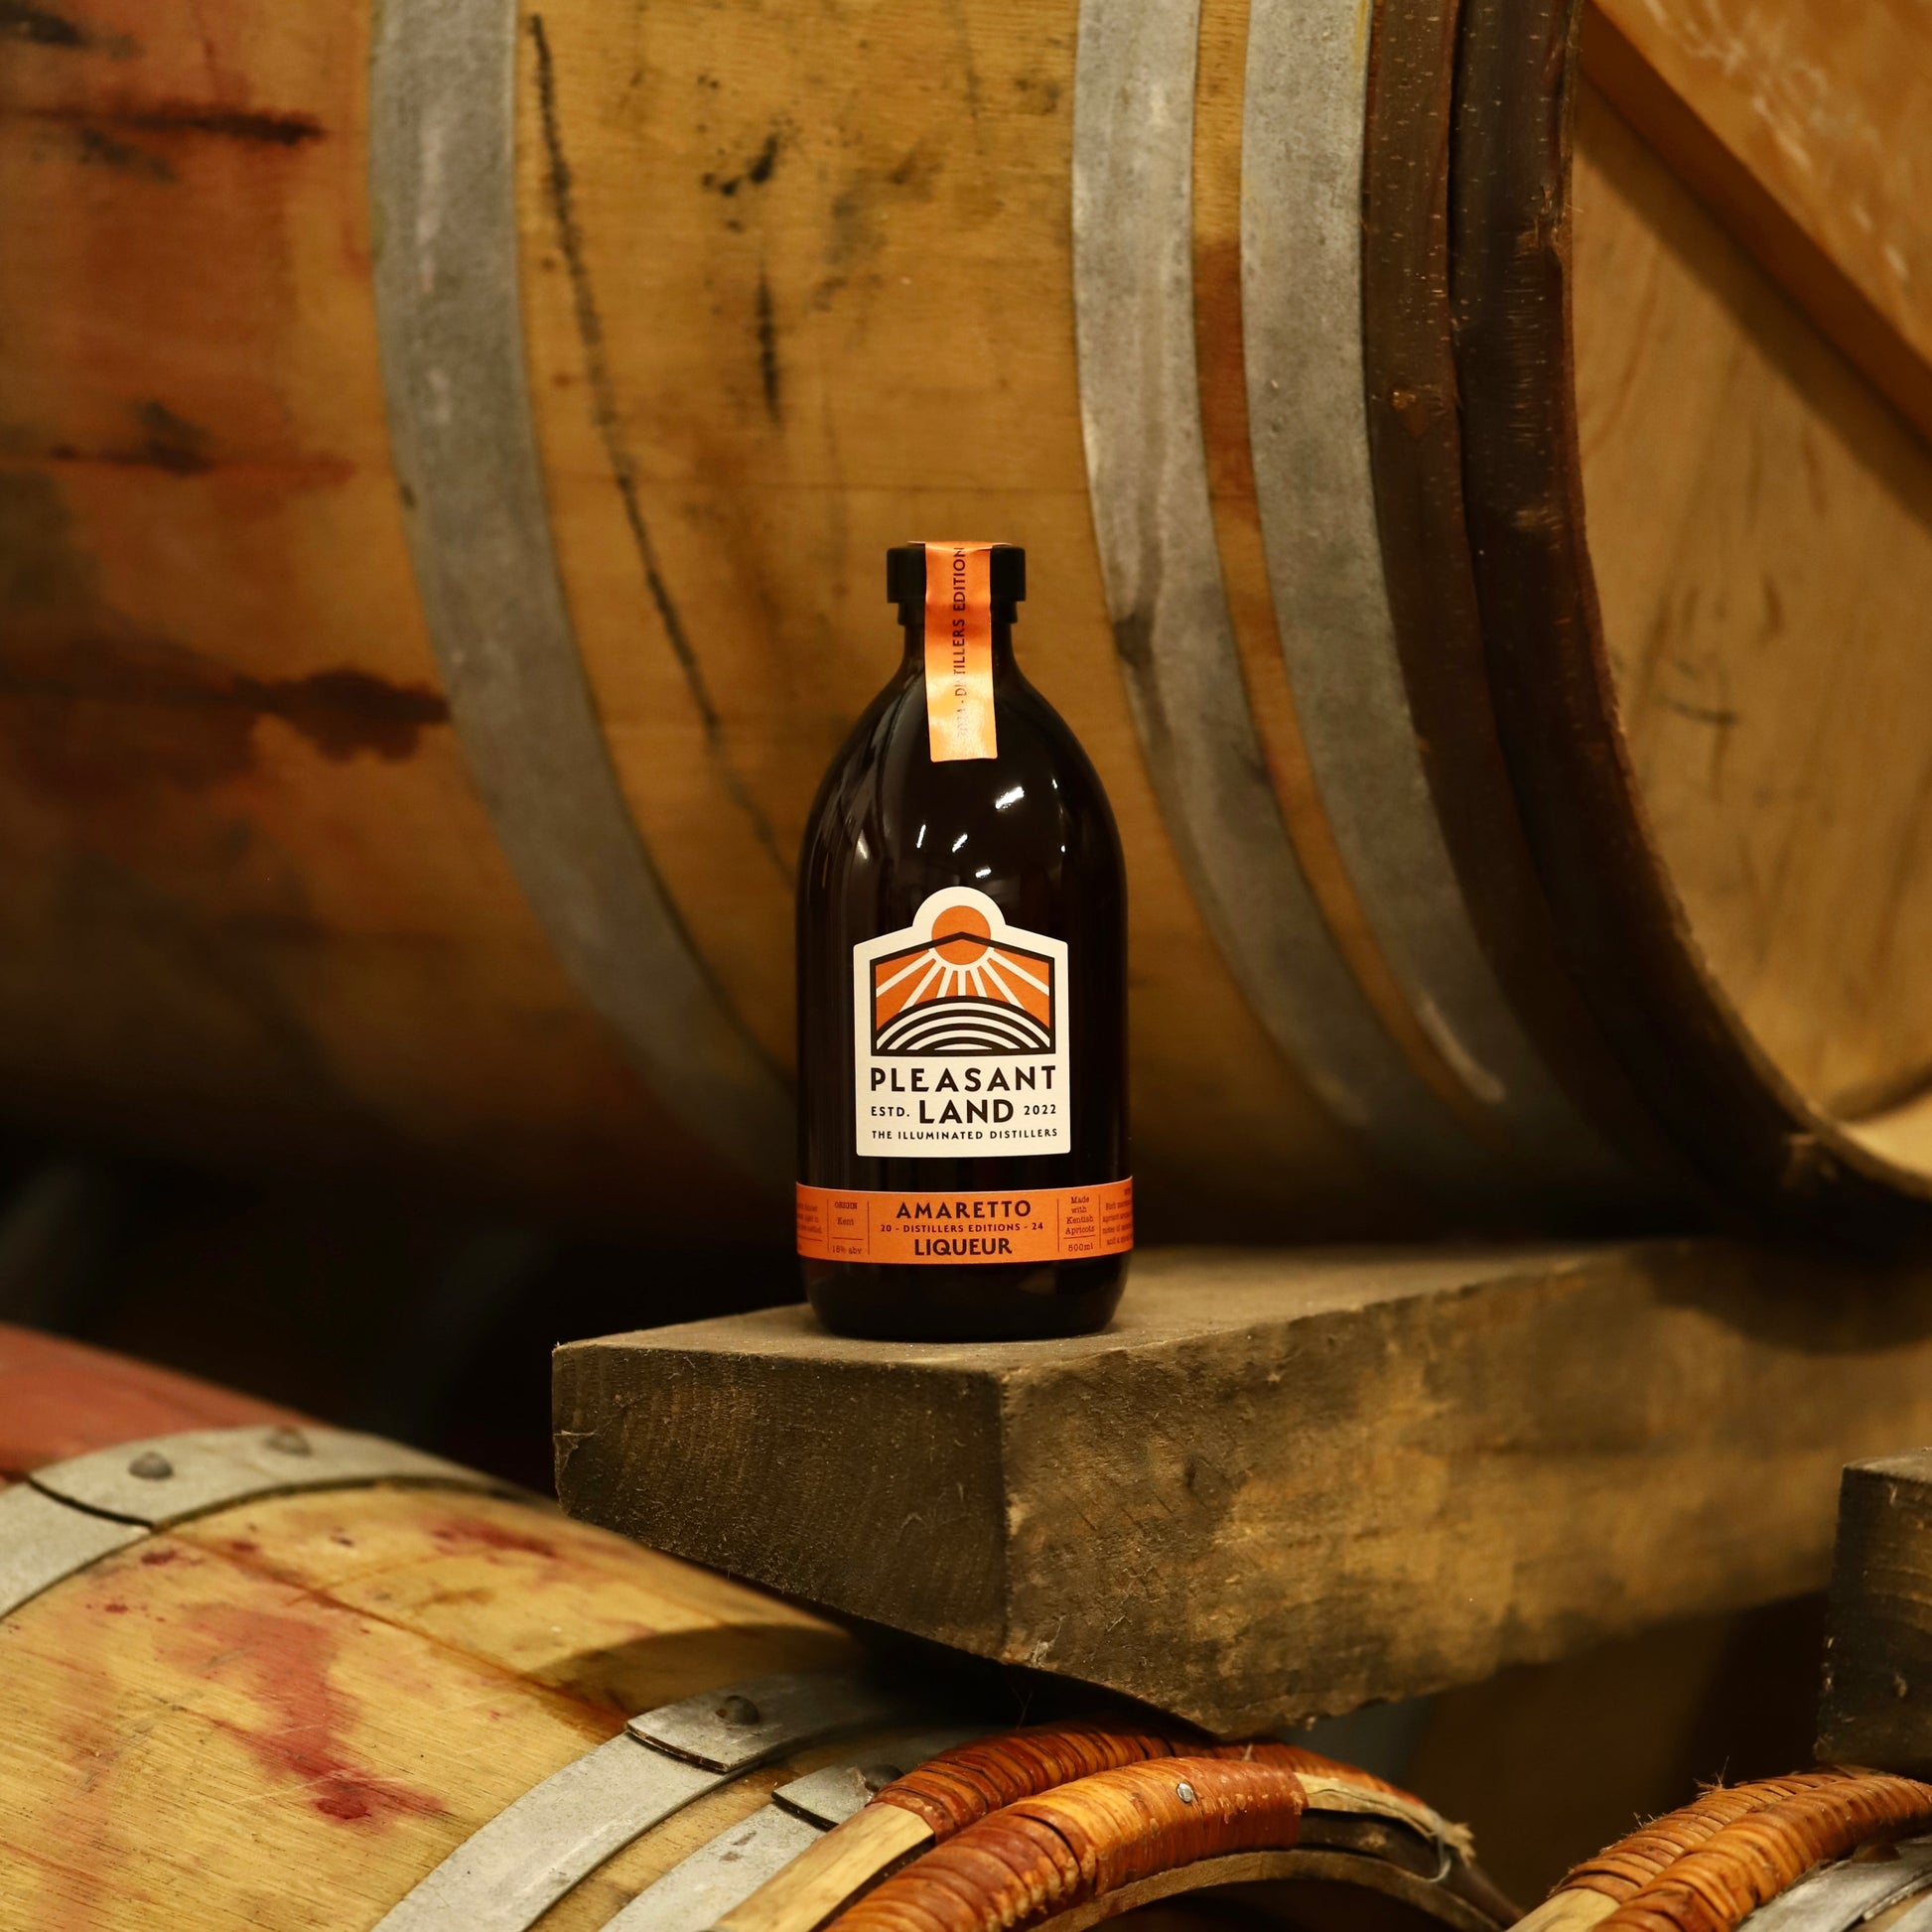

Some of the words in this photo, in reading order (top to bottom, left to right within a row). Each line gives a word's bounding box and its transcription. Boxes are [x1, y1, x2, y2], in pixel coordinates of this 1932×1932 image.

[953, 619, 967, 697] DITILLERS
[871, 1065, 1056, 1092] PLEASANT
[871, 1106, 910, 1117] ESTD.
[919, 1099, 1015, 1124] LAND
[1024, 1104, 1057, 1116] 2022
[872, 1130, 893, 1140] THE
[897, 1131, 984, 1140] ILLUMINATED
[990, 1128, 1058, 1140] DISTILLERS
[1070, 1195, 1090, 1204] Made
[896, 1200, 1032, 1219] AMARETTO
[1071, 1205, 1087, 1214] with
[837, 1217, 855, 1226] Kent
[1066, 1215, 1094, 1224] Kentish
[903, 1224, 964, 1233] DISTILLERS
[968, 1222, 1021, 1232] EDITIONS
[1032, 1221, 1044, 1231] 24
[1064, 1225, 1095, 1236] Apricots
[848, 1246, 862, 1255] abv
[914, 1238, 1013, 1256] LIQUEUR
[1068, 1243, 1094, 1252] 500ml
